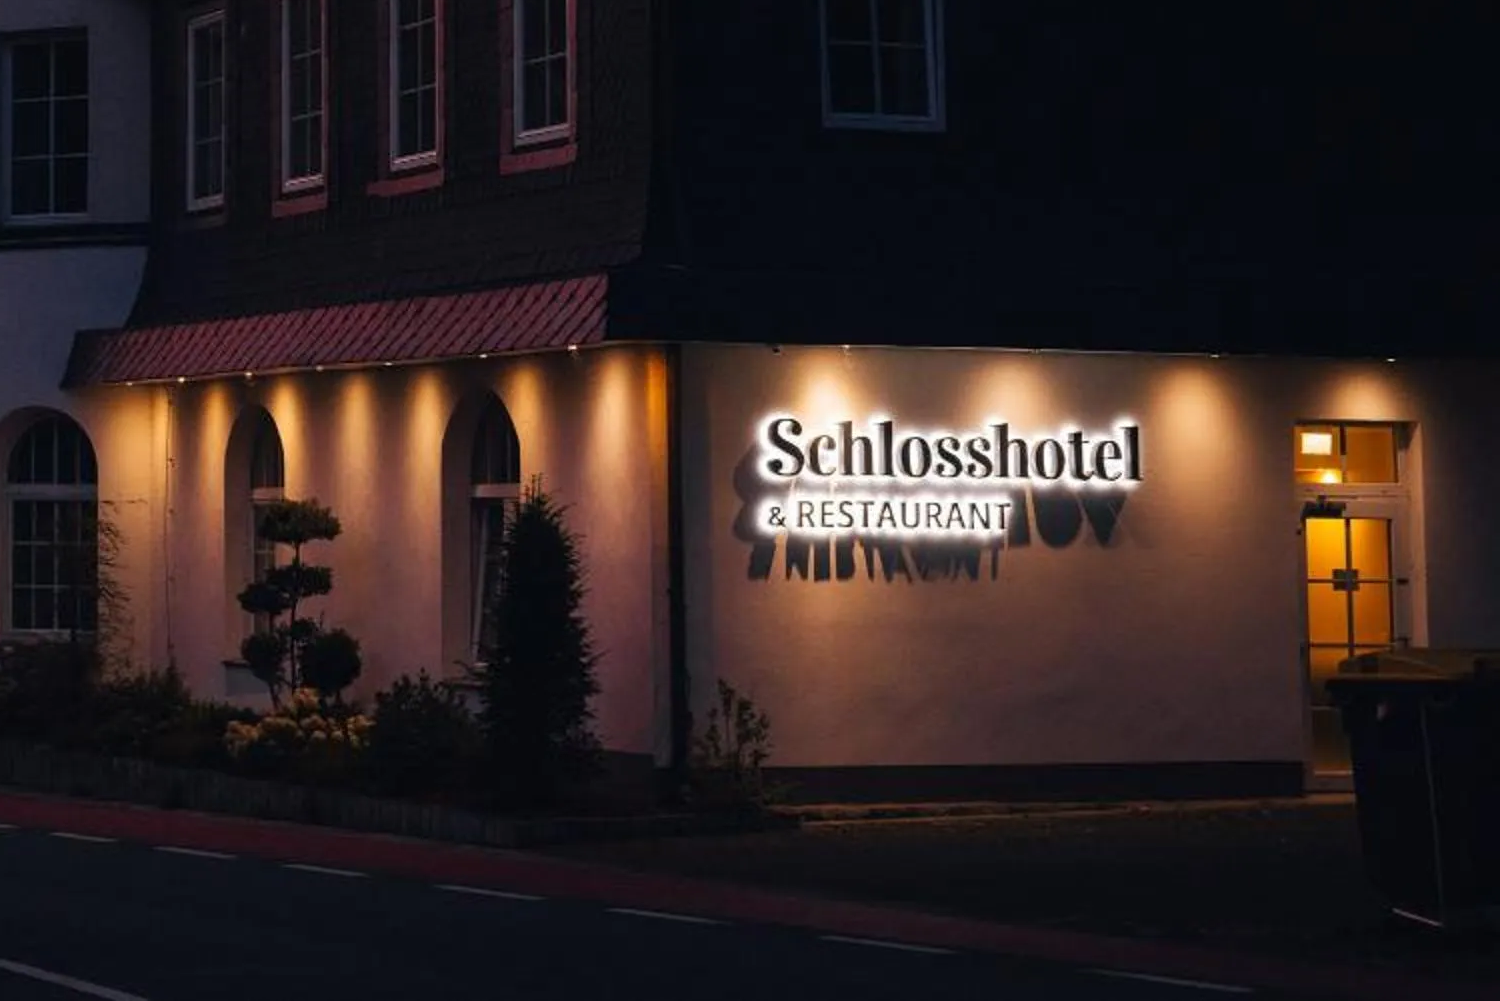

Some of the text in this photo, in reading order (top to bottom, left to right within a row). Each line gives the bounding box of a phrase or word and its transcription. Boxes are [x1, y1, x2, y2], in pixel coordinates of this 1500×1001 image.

[766, 417, 1144, 482] Schlosshotel
[767, 499, 1011, 530] & RESTAURANT
